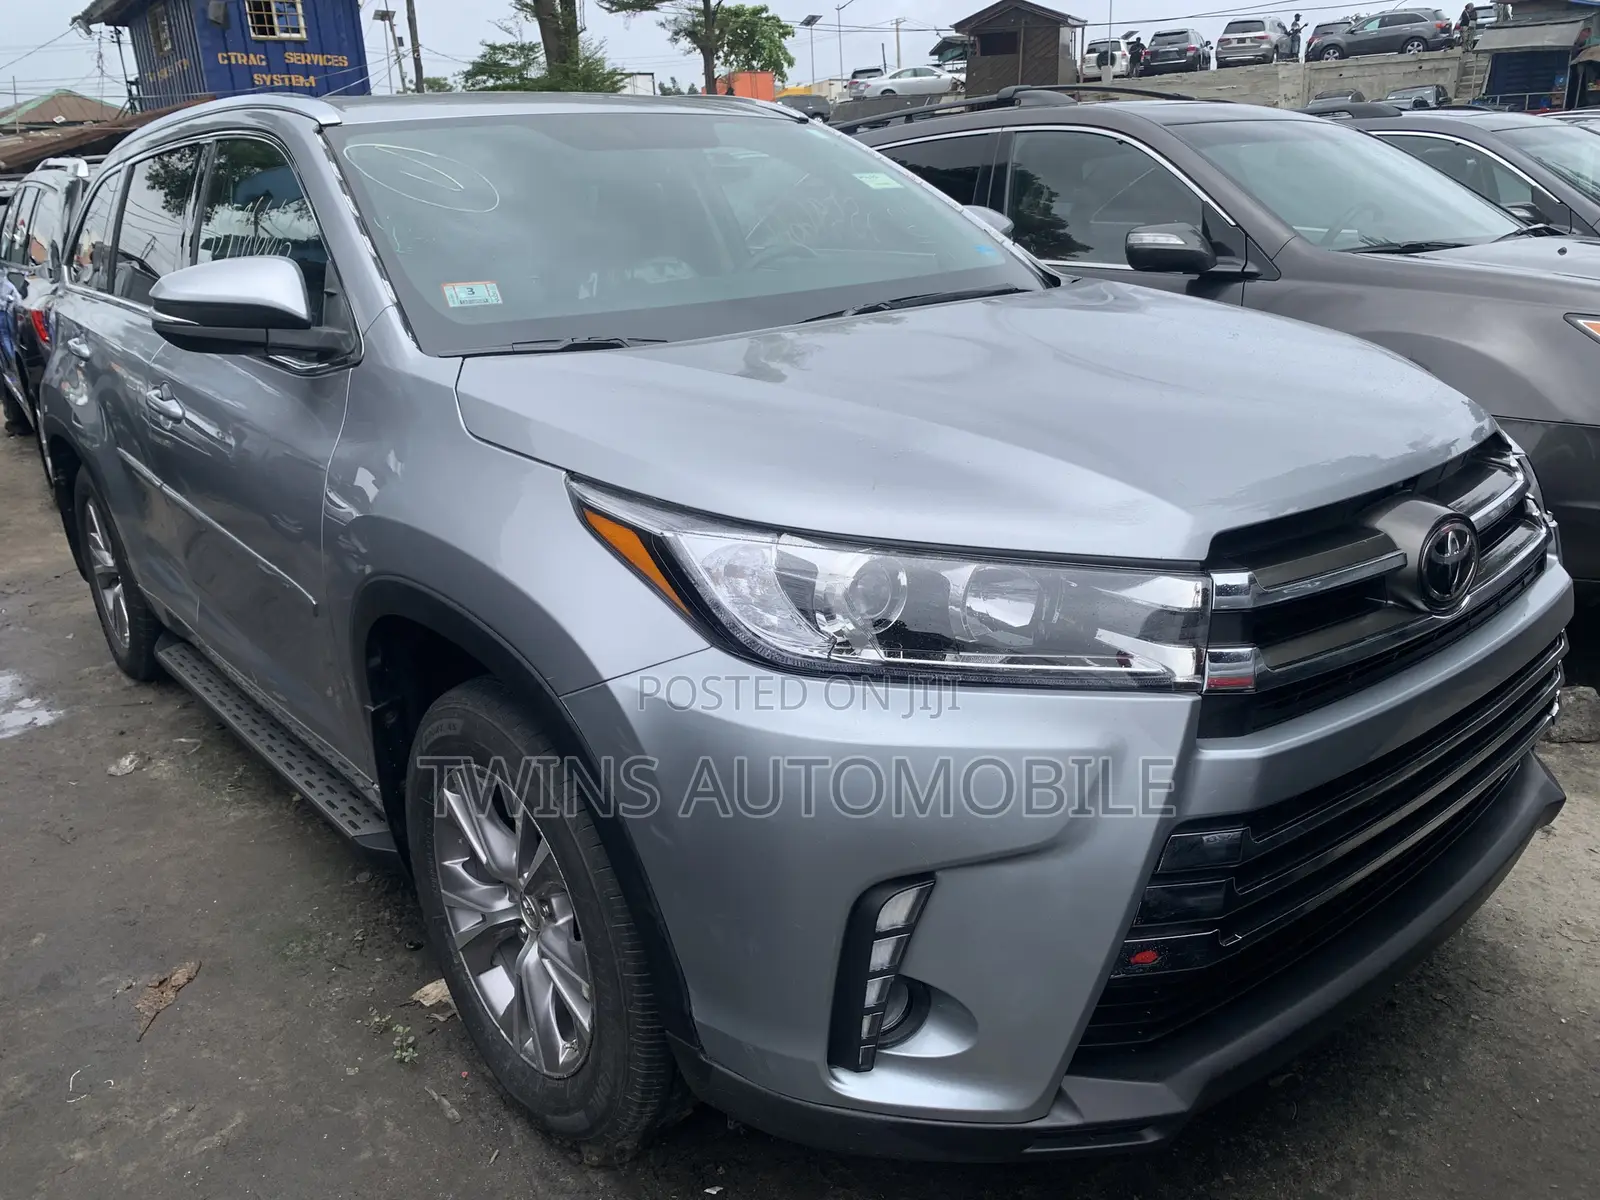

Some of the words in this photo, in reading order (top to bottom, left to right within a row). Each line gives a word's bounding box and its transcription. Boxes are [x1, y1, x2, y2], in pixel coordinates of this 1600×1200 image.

[217, 52, 267, 66] CTRAC
[284, 51, 349, 67] SERVICES
[253, 73, 317, 87] SYSTEM
[466, 287, 476, 296] 3
